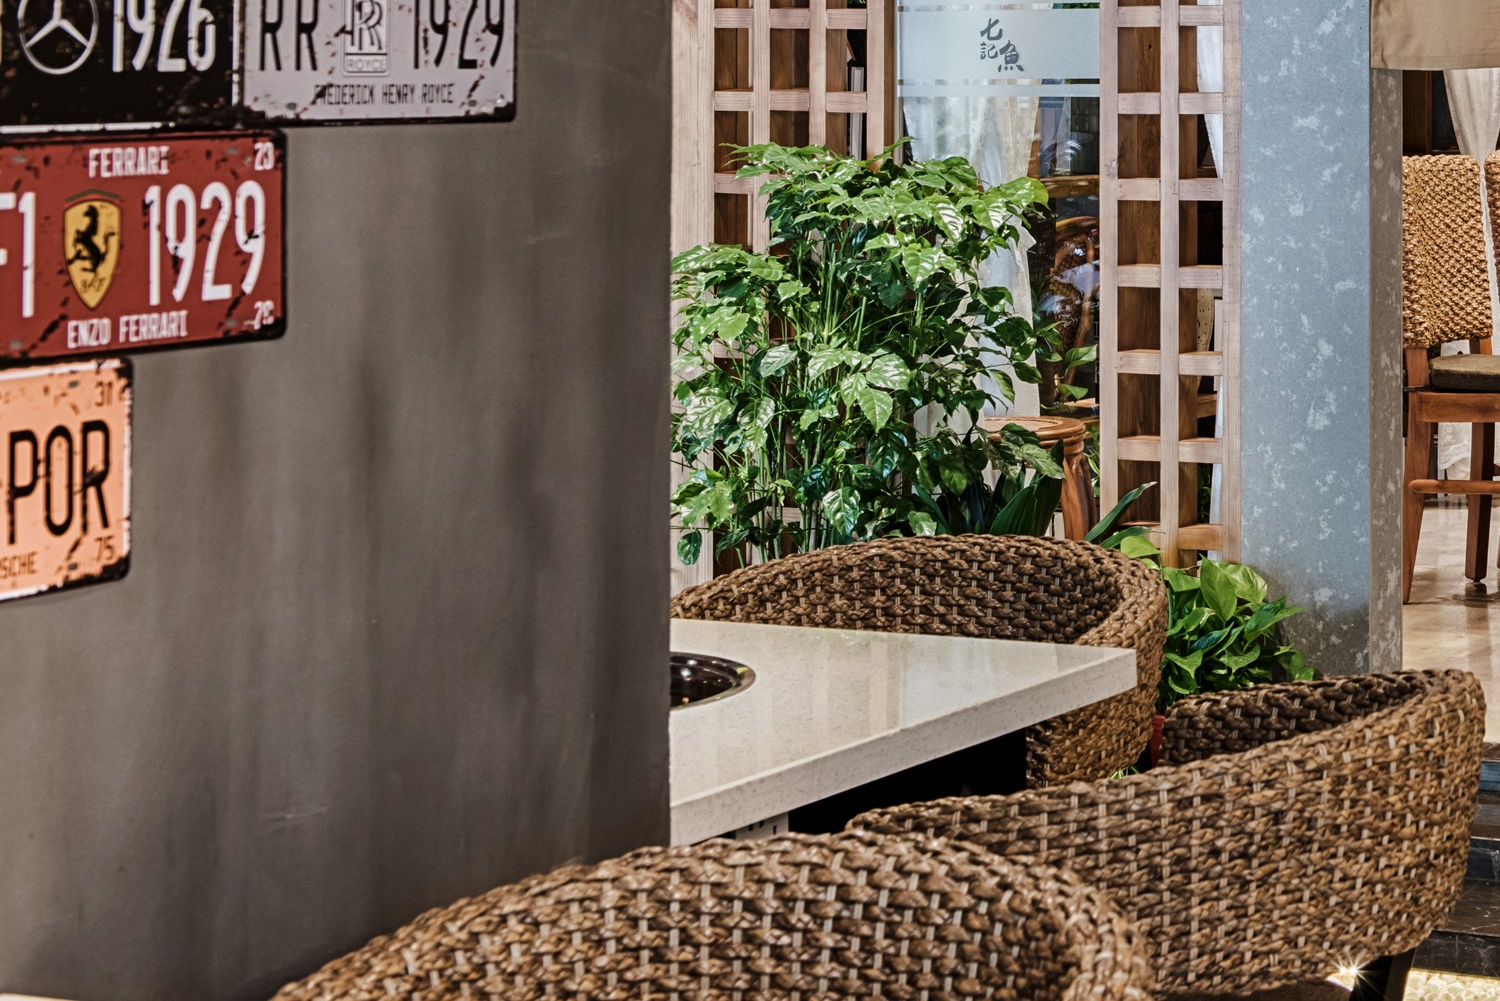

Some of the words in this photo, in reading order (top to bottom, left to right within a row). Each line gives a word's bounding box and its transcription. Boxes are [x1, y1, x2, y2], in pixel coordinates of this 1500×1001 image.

[382, 83, 416, 104] HENRY
[422, 83, 455, 103] ROYCE
[88, 146, 170, 178] FERRARI
[144, 180, 266, 306] 1929
[67, 317, 111, 349] ENZO
[119, 310, 189, 344] FERRARI
[8, 420, 110, 545] POR
